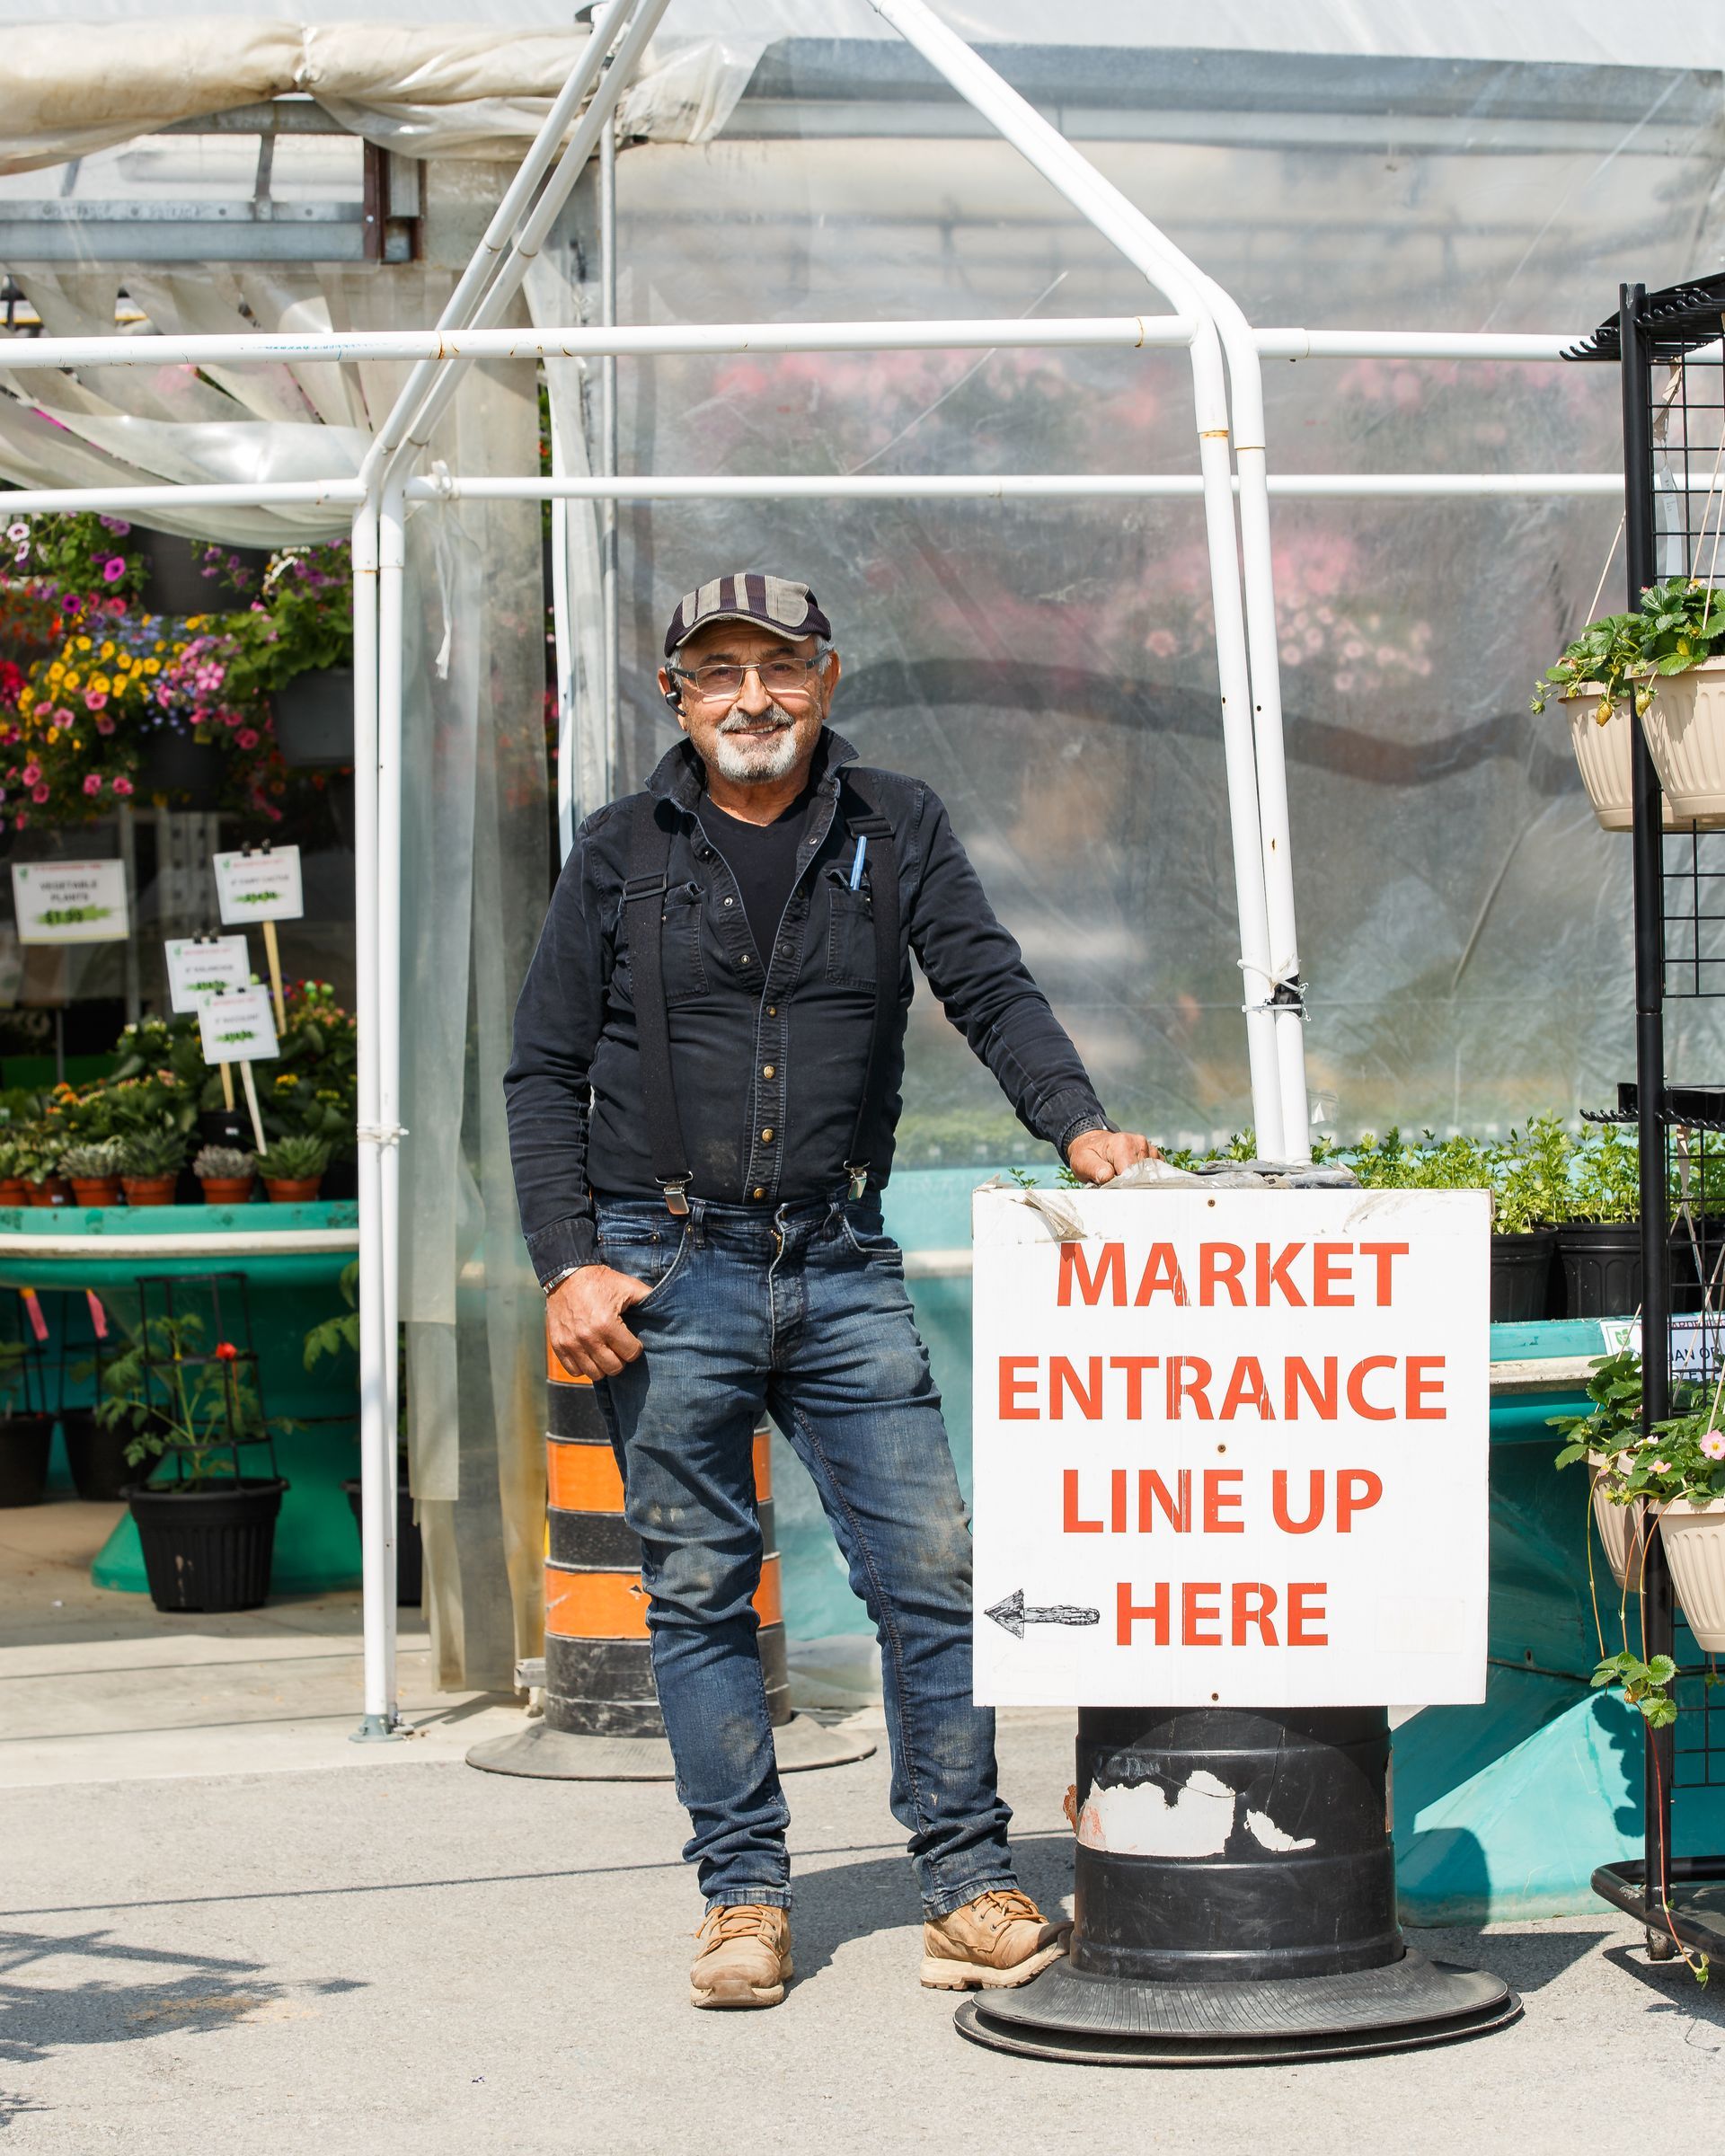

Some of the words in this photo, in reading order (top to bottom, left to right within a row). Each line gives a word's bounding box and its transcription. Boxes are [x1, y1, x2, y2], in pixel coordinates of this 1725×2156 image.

[40, 880, 97, 890] VEGETABLE
[50, 893, 89, 902] PLANTS
[1057, 1242, 1409, 1306] MARKET
[999, 1356, 1446, 1420] ENTRANCE
[1064, 1470, 1243, 1533] LINE
[1273, 1470, 1382, 1533] UP
[1117, 1583, 1328, 1646] HERE
